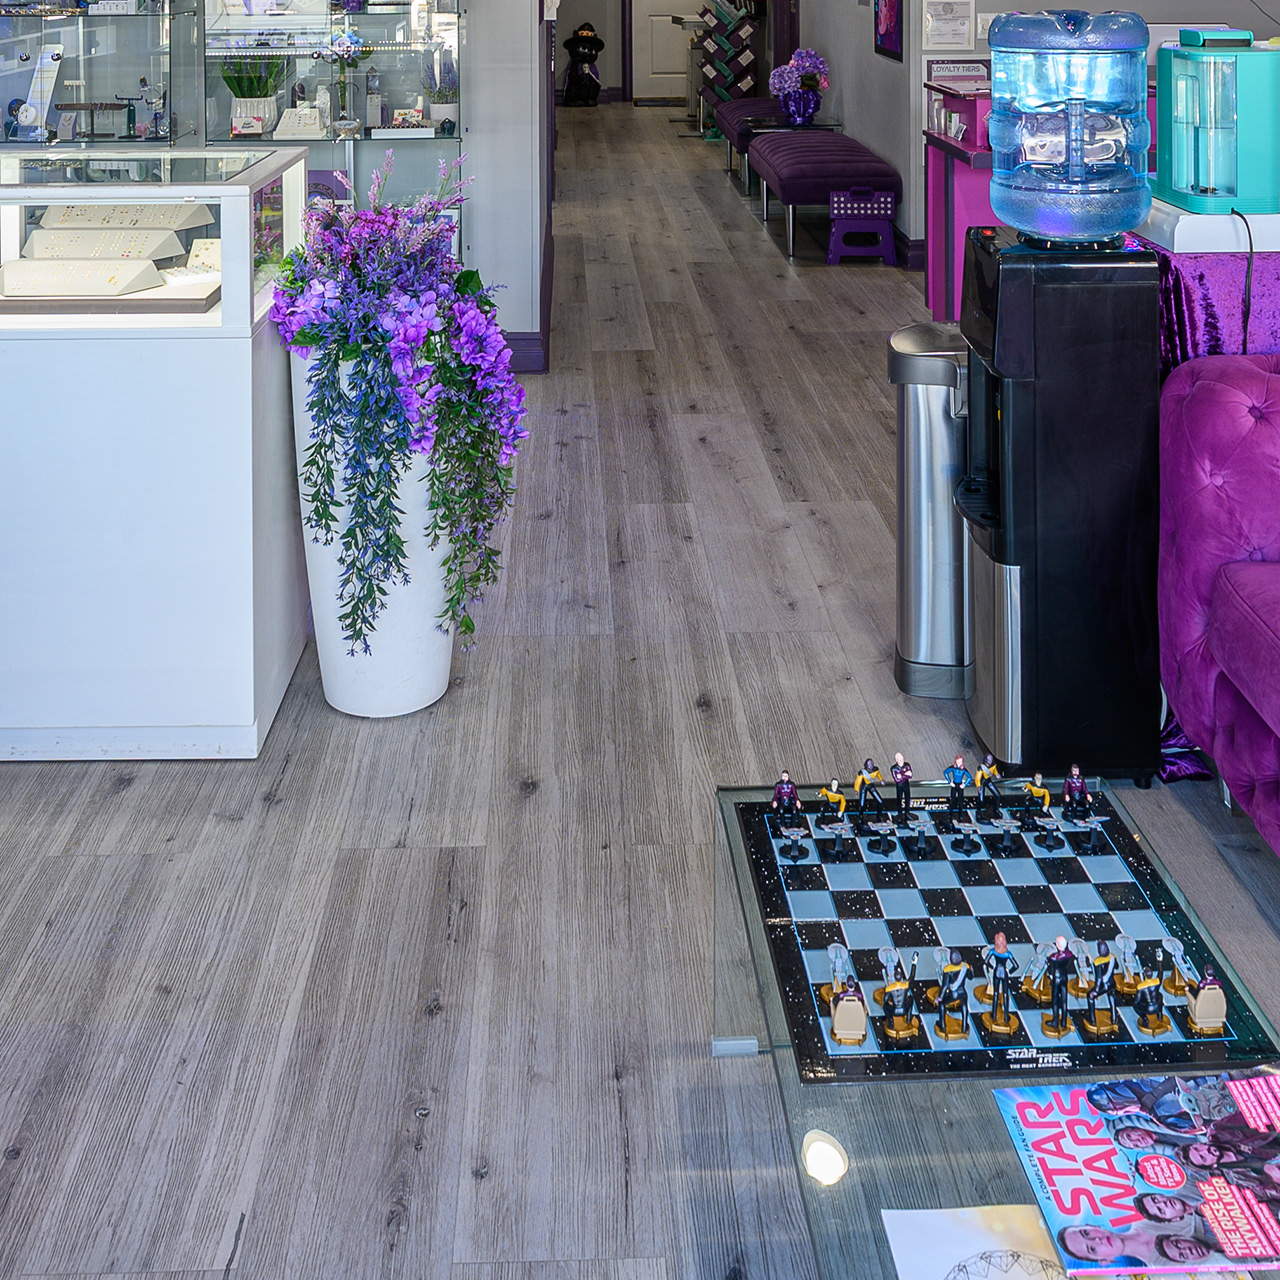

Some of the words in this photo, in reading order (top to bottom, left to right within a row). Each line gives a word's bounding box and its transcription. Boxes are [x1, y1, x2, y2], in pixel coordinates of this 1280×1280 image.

[1006, 1048, 1037, 1059] STAR
[1037, 1053, 1071, 1063] TREK
[1011, 1115, 1025, 1138] GUIDE
[1016, 1101, 1103, 1216] STAR
[1021, 1137, 1032, 1153] FAN
[1051, 1089, 1146, 1228] WARS
[1027, 1154, 1050, 1196] COMPLETE
[1199, 1183, 1218, 1199] OF
[1209, 1201, 1235, 1228] RISE
[1211, 1178, 1266, 1254] SKYWALKER
[1201, 1204, 1235, 1255] CELEBRATING
[1225, 1231, 1250, 1255] THE
